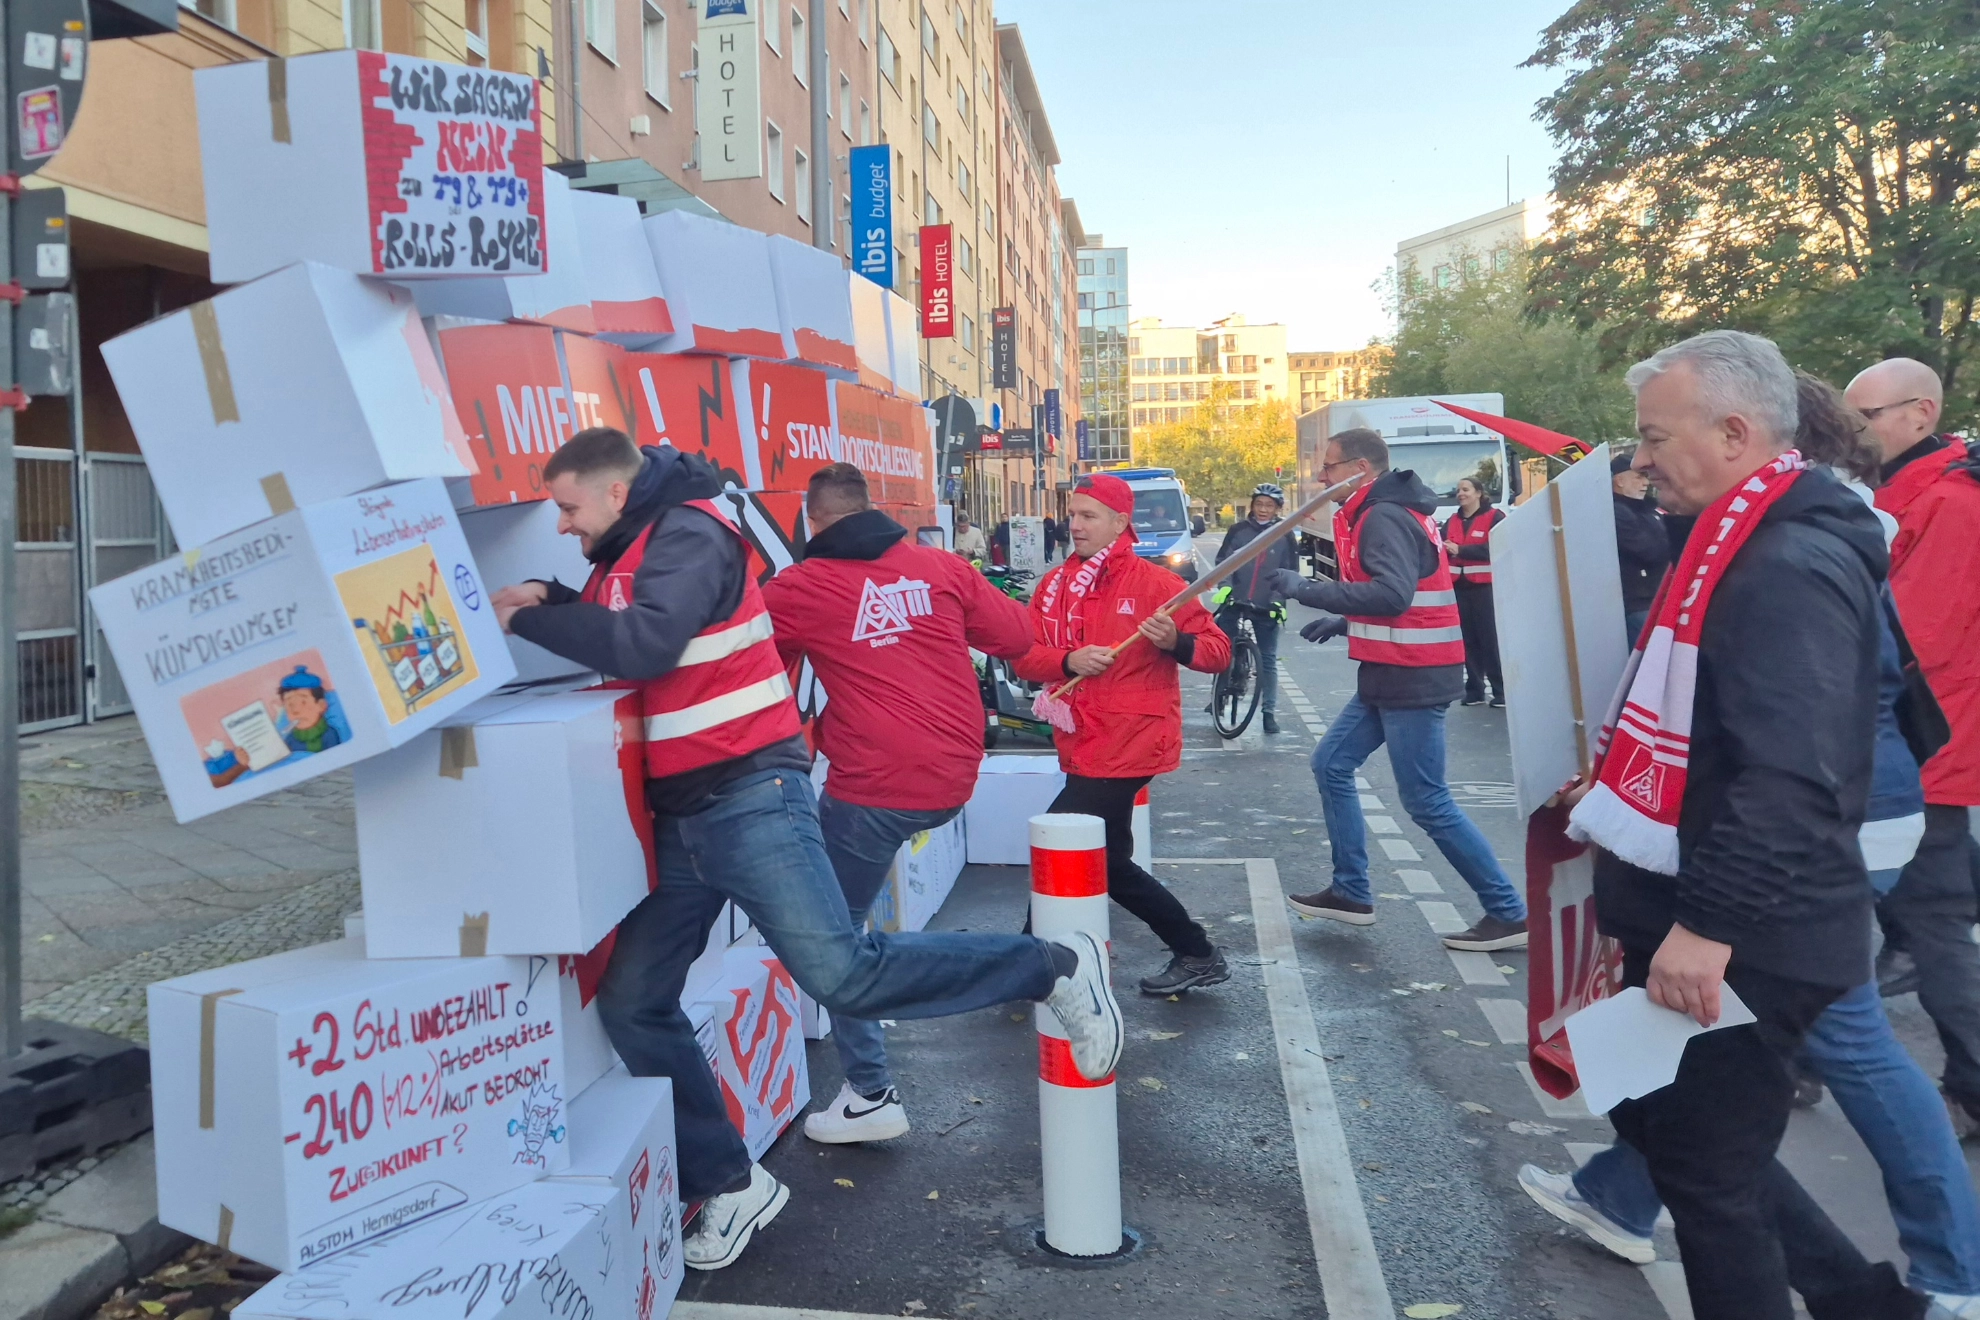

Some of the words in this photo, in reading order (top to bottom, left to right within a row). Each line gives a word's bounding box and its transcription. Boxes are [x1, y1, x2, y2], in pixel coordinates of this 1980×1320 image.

[454, 71, 531, 122] SAGEN
[720, 33, 735, 162] HOTEL
[868, 162, 888, 219] budget
[861, 227, 886, 274] ibis
[935, 239, 948, 282] HOTEL
[929, 286, 949, 324] ibis
[996, 314, 1010, 323] ibis
[1000, 332, 1008, 383] HOTEL
[982, 434, 999, 444] ibis
[869, 635, 899, 648] Berlin
[288, 1011, 345, 1077] +2
[353, 999, 409, 1060] Std.
[410, 982, 512, 1044] UNBEZAHLT
[284, 1081, 374, 1159] -240
[438, 1020, 555, 1078] Arbeitsplätze
[439, 1083, 478, 1117] AKUT
[484, 1059, 550, 1107] BEDROHT
[361, 1188, 441, 1237] Hennigsdorf
